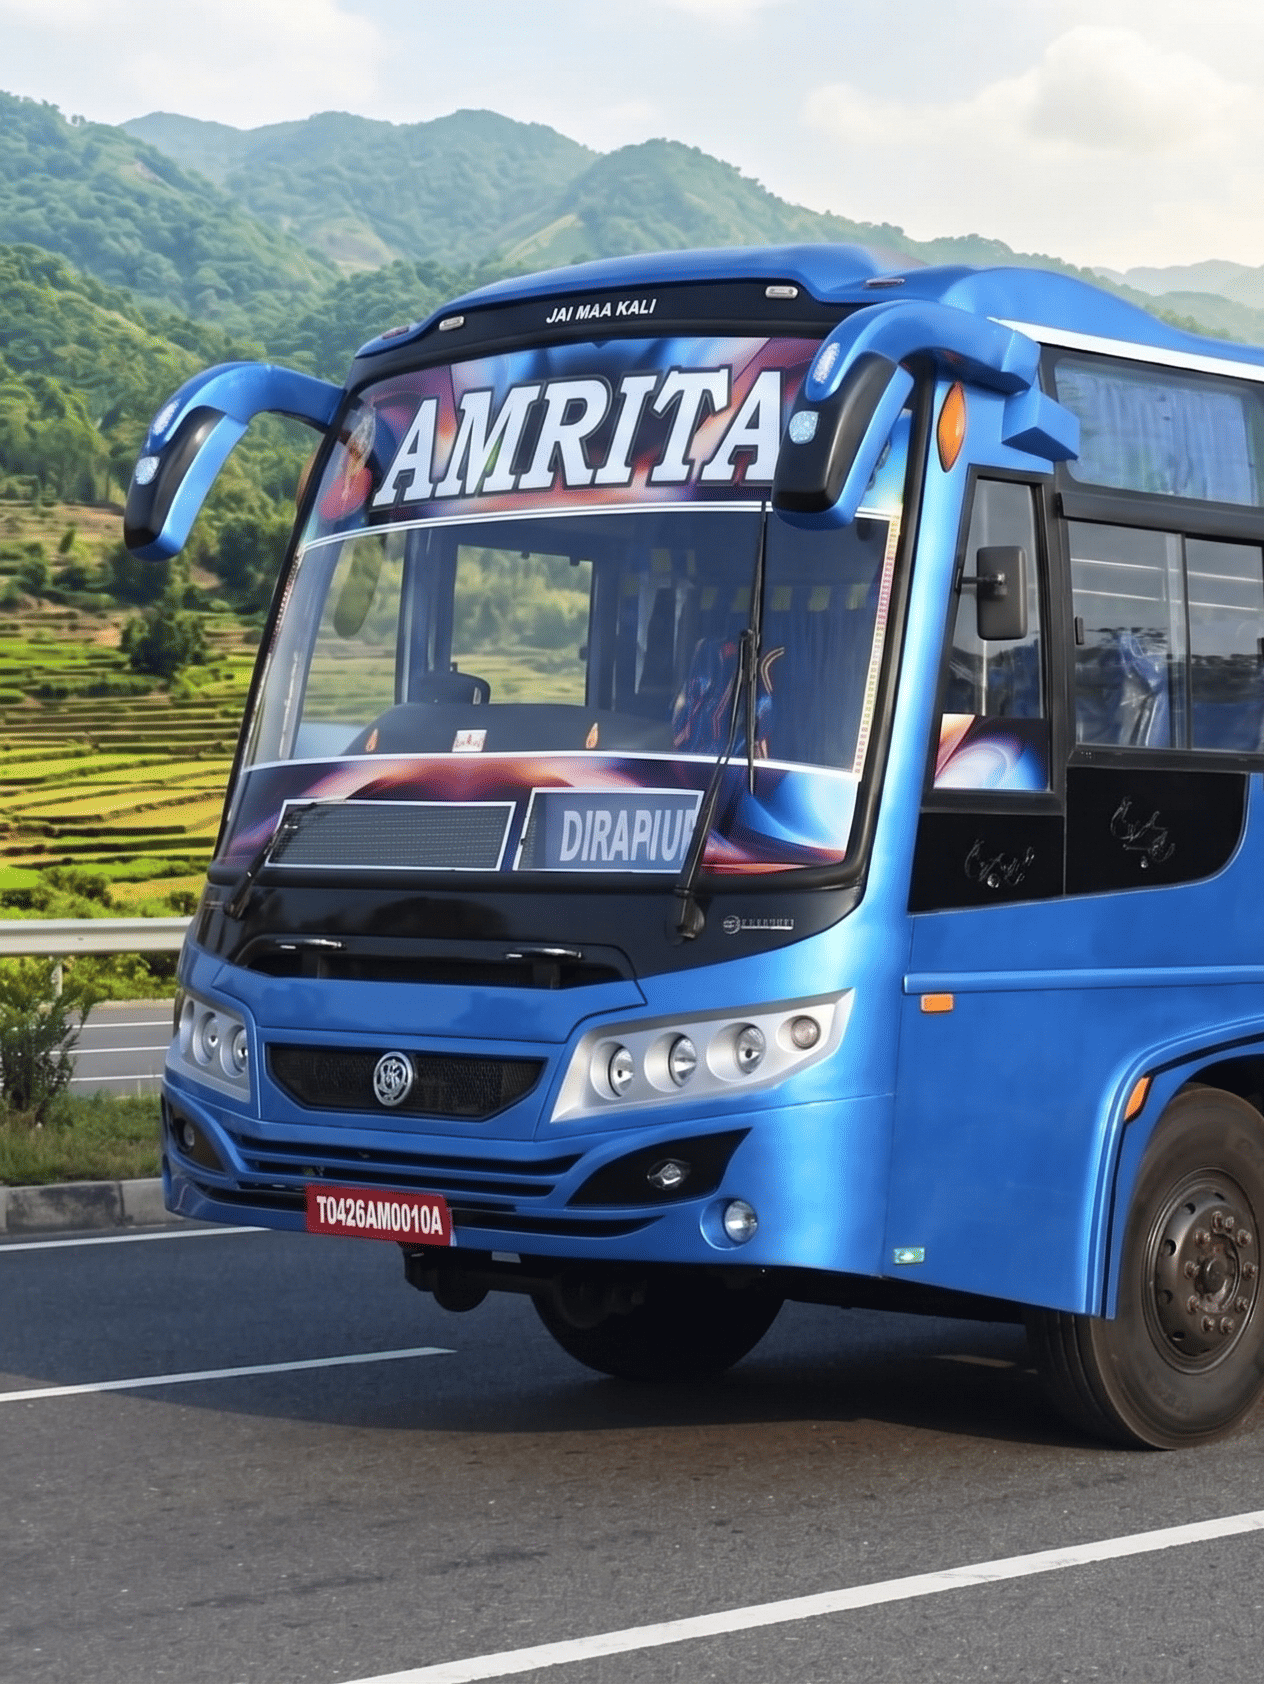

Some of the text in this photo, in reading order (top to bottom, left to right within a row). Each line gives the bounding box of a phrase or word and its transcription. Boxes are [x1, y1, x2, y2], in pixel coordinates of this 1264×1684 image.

[546, 298, 657, 323] JAI MAA KALI
[372, 368, 785, 507] AMRITA
